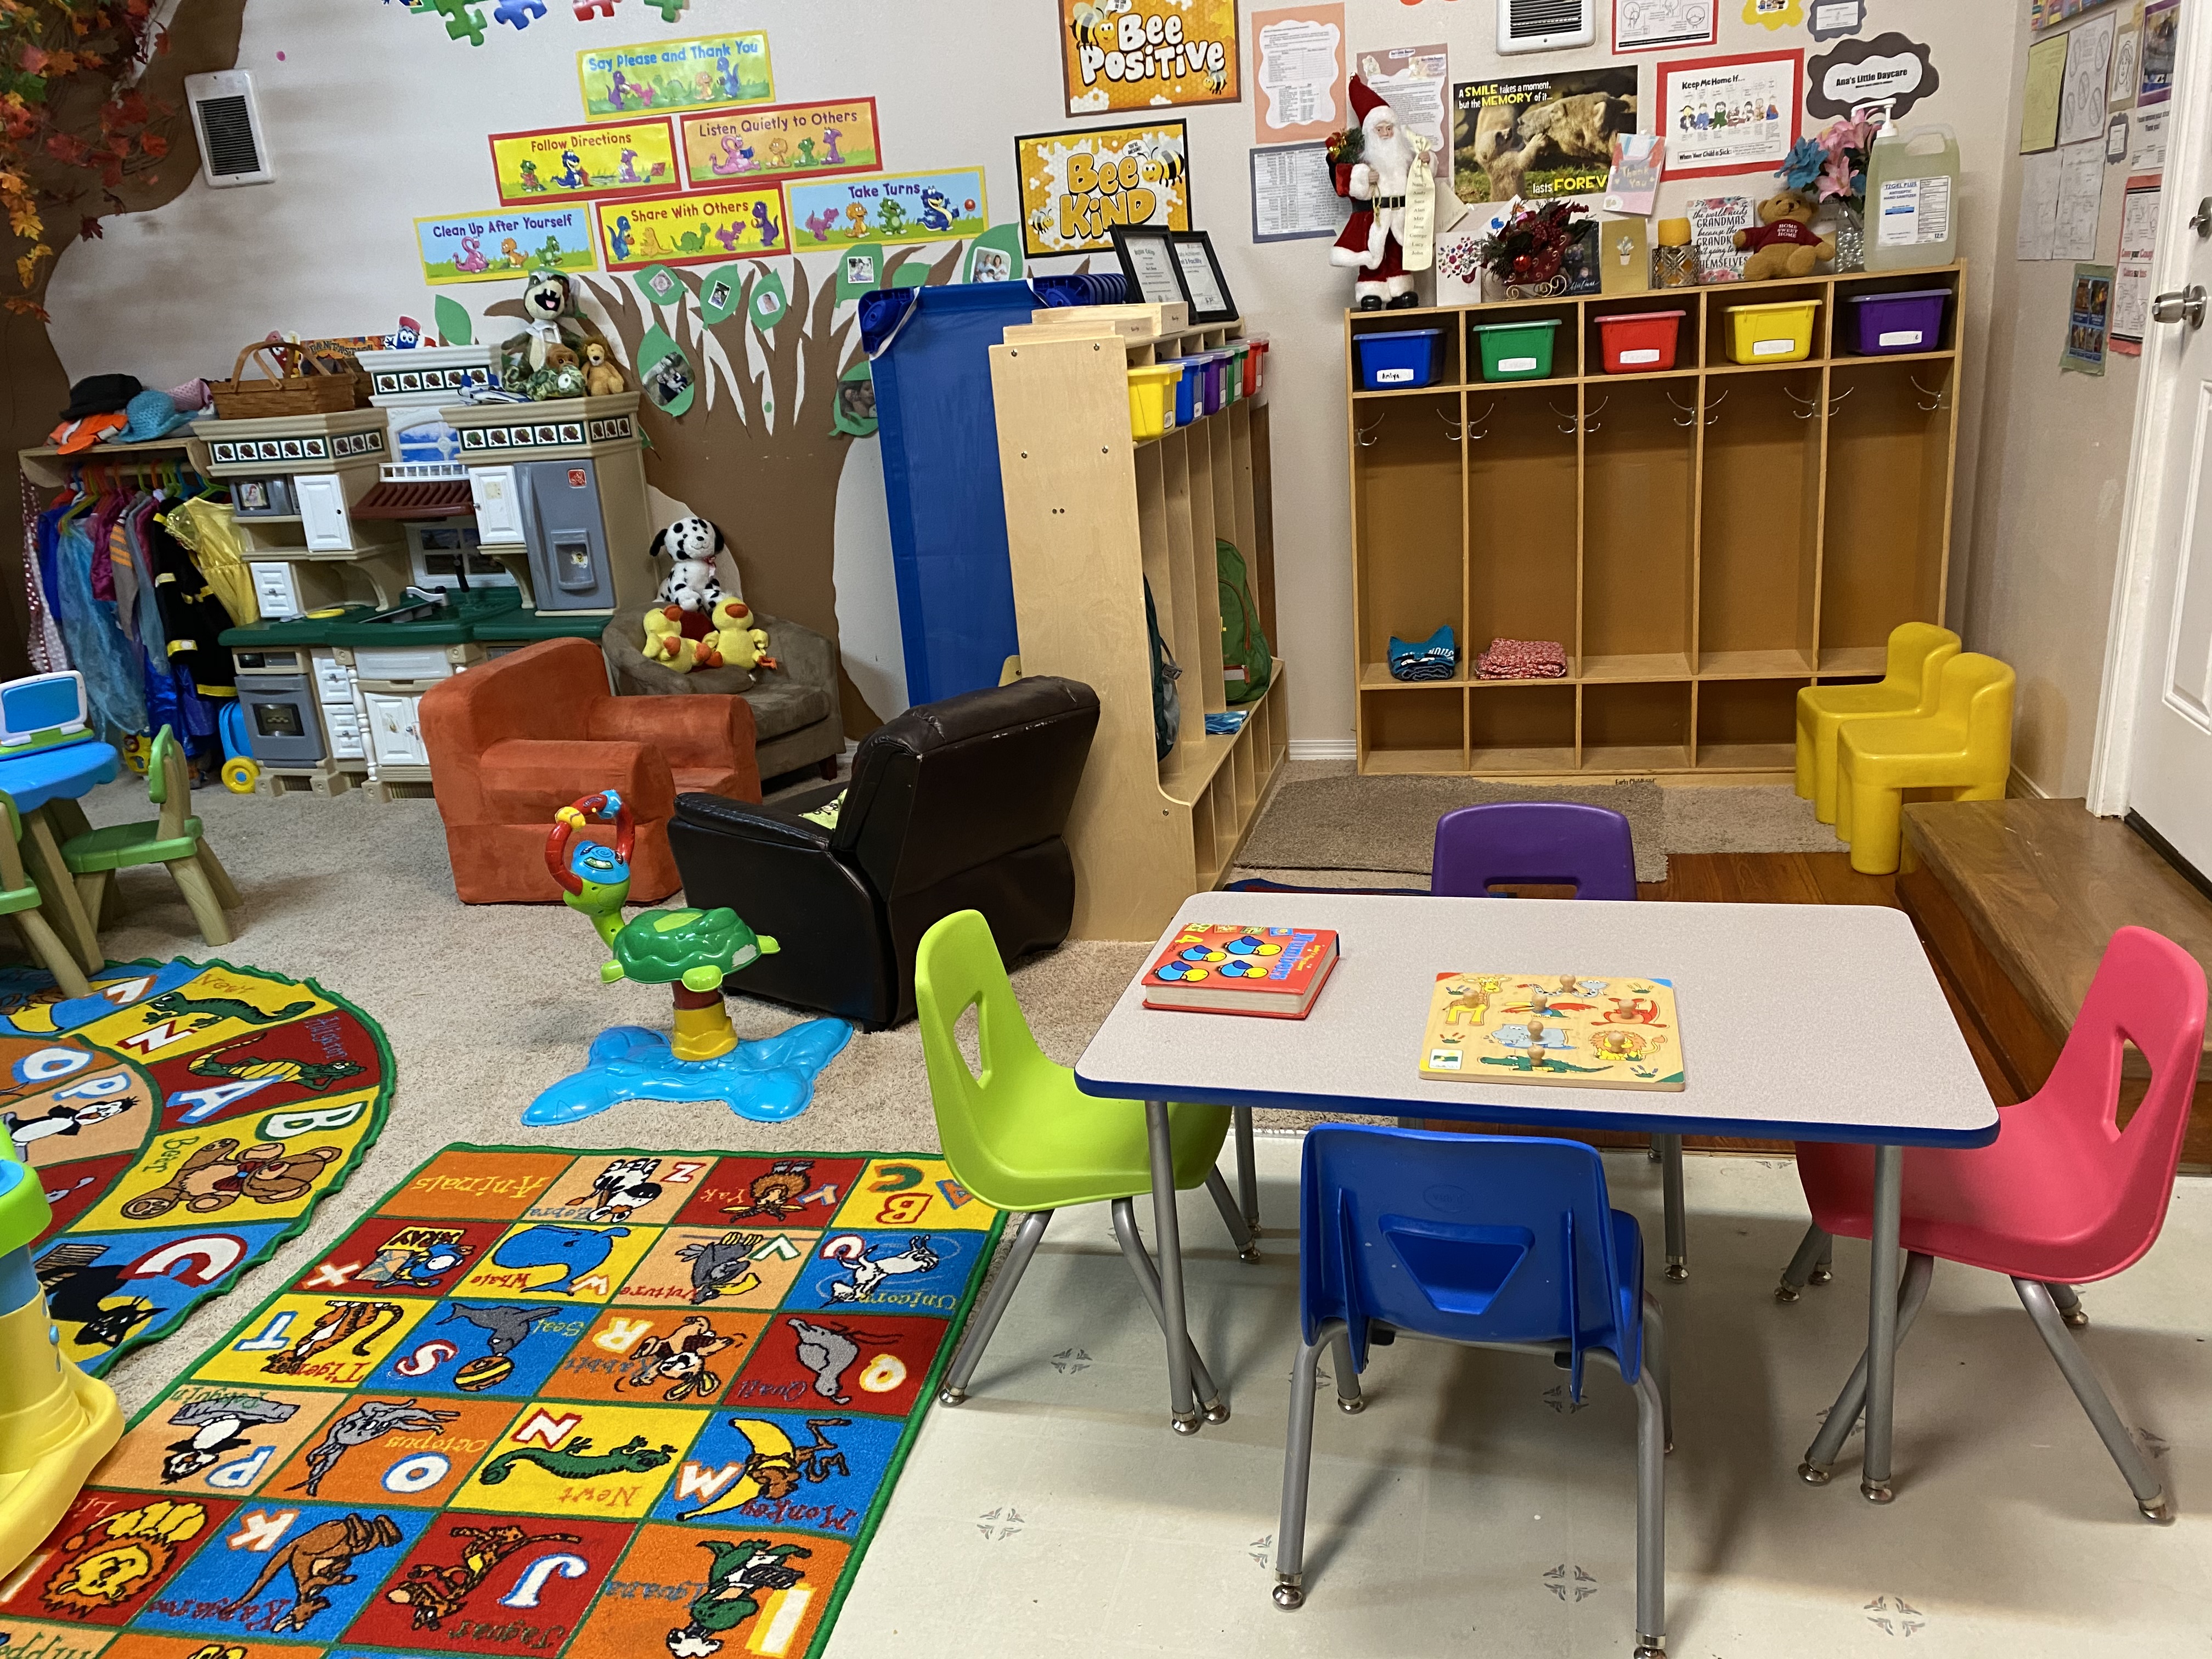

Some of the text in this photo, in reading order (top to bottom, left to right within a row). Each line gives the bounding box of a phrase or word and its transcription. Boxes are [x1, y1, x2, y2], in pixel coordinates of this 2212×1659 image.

[1118, 13, 1183, 52] Bee
[589, 40, 758, 72] Say Please and Thank You
[1682, 80, 1700, 90] Keep
[1701, 78, 1711, 87] Me
[1712, 77, 1731, 86] Home
[1836, 77, 1855, 86] Ana's
[1857, 75, 1876, 83] Little
[1877, 69, 1908, 80] Daycare
[1459, 89, 1464, 98] A
[1465, 84, 1498, 97] SMILE
[1500, 84, 1516, 94] takes
[1459, 101, 1469, 109] but
[1471, 99, 1481, 108] the
[1481, 92, 1532, 107] MEMORY
[1534, 92, 1541, 101] of
[699, 110, 857, 138] Listen Quietly to Others
[531, 133, 631, 153] Follow Directions
[1067, 153, 1139, 195] Bee
[1533, 174, 1608, 194] lasts FOREV
[848, 182, 921, 198] Take Turns
[631, 201, 748, 221] Share With Others
[1693, 205, 1748, 219] the world needs
[1697, 216, 1746, 228] GRANDMAS
[433, 214, 572, 238] Clean Up After Yourself
[1697, 225, 1740, 237] because the
[1697, 235, 1733, 246] GRANDK
[1708, 247, 1726, 259] going
[1728, 245, 1734, 253] to
[1700, 256, 1748, 269] HEMSELVES
[193, 973, 256, 994] Newt
[53, 1071, 132, 1101] P
[166, 1074, 284, 1124] A
[255, 1101, 368, 1142] B
[142, 1136, 200, 1173] Bear
[659, 1161, 708, 1186] Z
[866, 1163, 927, 1193] C
[411, 1174, 554, 1199] Animals
[699, 1187, 748, 1205] Yak
[796, 1183, 841, 1207] Y
[876, 1192, 935, 1226] B
[747, 1233, 802, 1262] V
[116, 1233, 248, 1288] C
[301, 1260, 362, 1290] X
[470, 1272, 532, 1288] Whale
[617, 1284, 698, 1301] Vulture
[233, 1309, 299, 1353] T
[531, 1318, 586, 1337] Seal
[591, 1316, 656, 1354] R
[394, 1338, 459, 1378] S
[562, 1355, 660, 1378] Rabbit
[296, 1361, 374, 1384] Tiger
[737, 1379, 807, 1402] Quail
[510, 1406, 583, 1449] N
[205, 1444, 276, 1488] P
[381, 1451, 452, 1494] O
[558, 1486, 643, 1508] Newt
[738, 1498, 859, 1532] Monkey
[224, 1508, 302, 1553] K
[496, 1553, 591, 1609] J
[603, 1577, 709, 1610] Iguana
[447, 1616, 569, 1650] Jaguar
